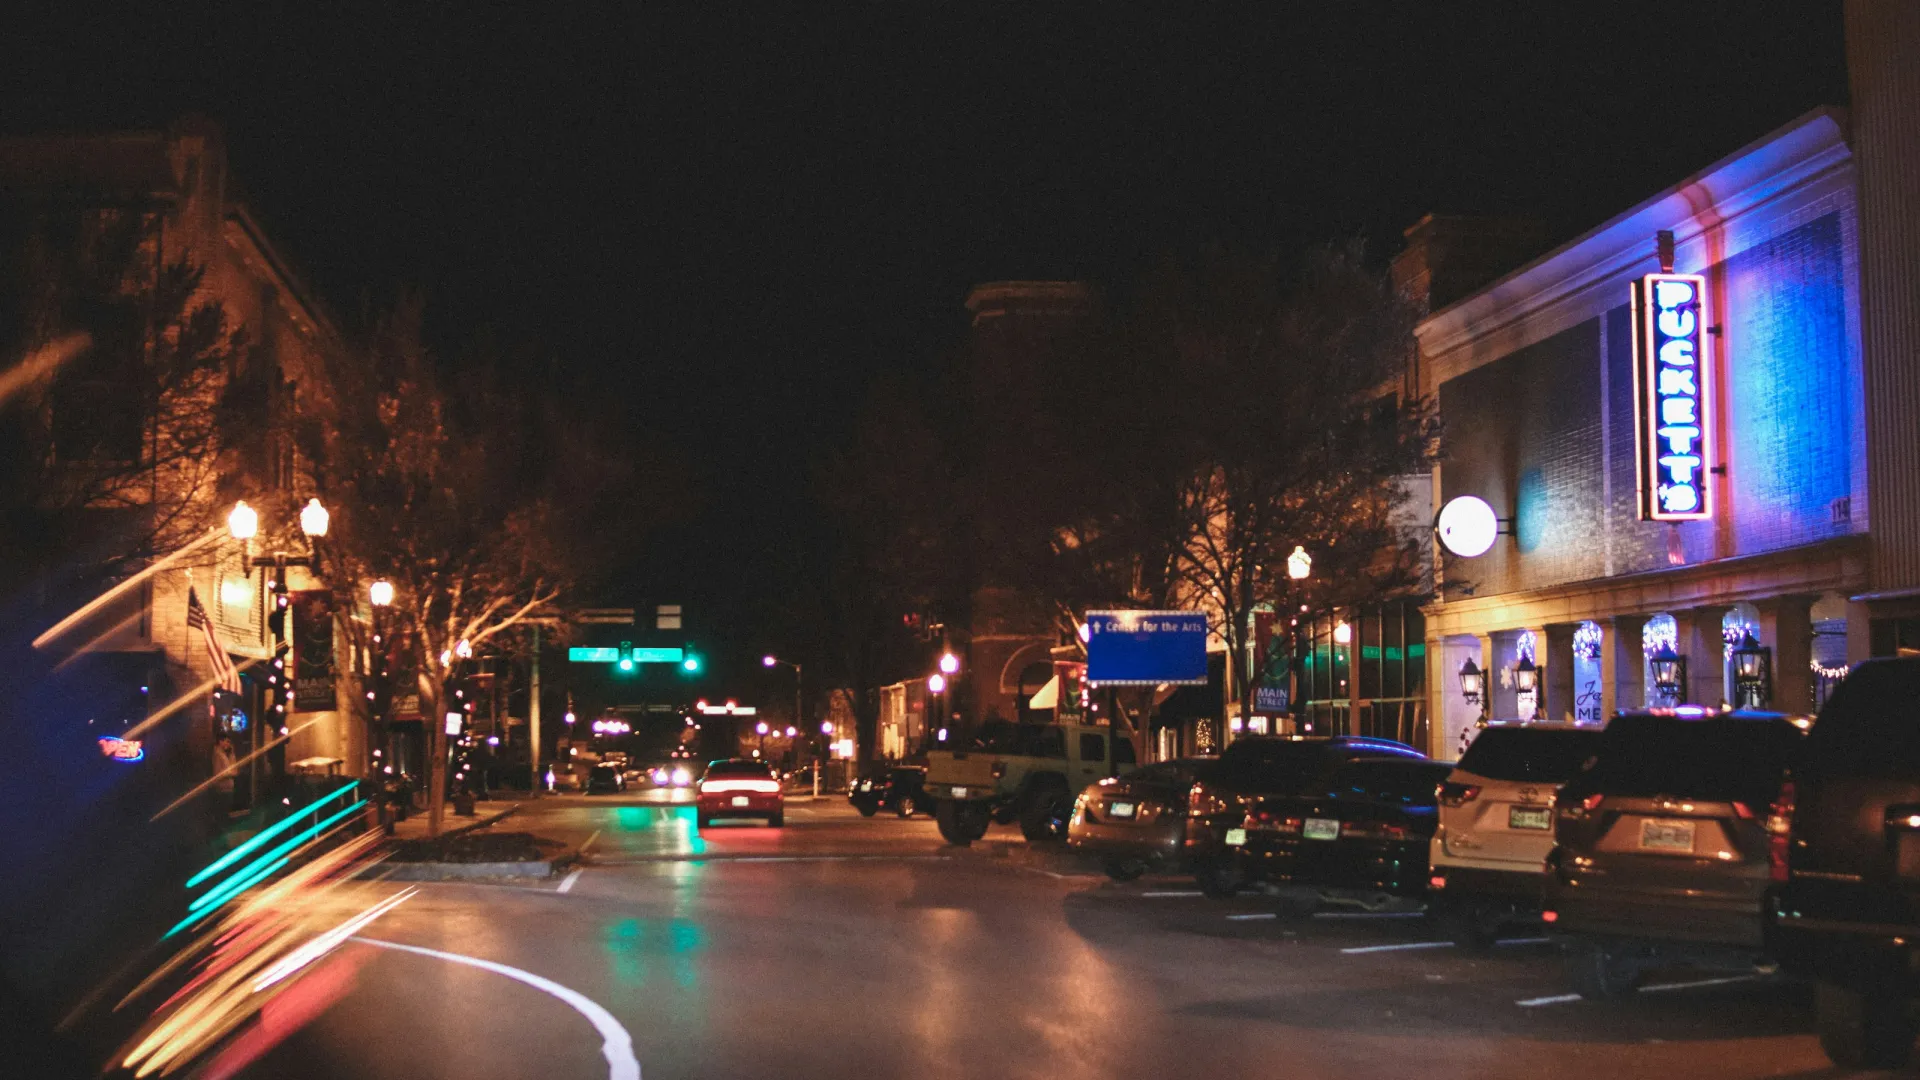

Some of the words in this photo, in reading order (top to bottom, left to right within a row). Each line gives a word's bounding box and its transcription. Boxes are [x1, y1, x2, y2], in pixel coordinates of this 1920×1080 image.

[1143, 620, 1158, 633] for
[1162, 621, 1178, 632] the
[1182, 621, 1202, 632] Arts
[1257, 687, 1287, 698] MAIN
[1256, 697, 1288, 706] STREET
